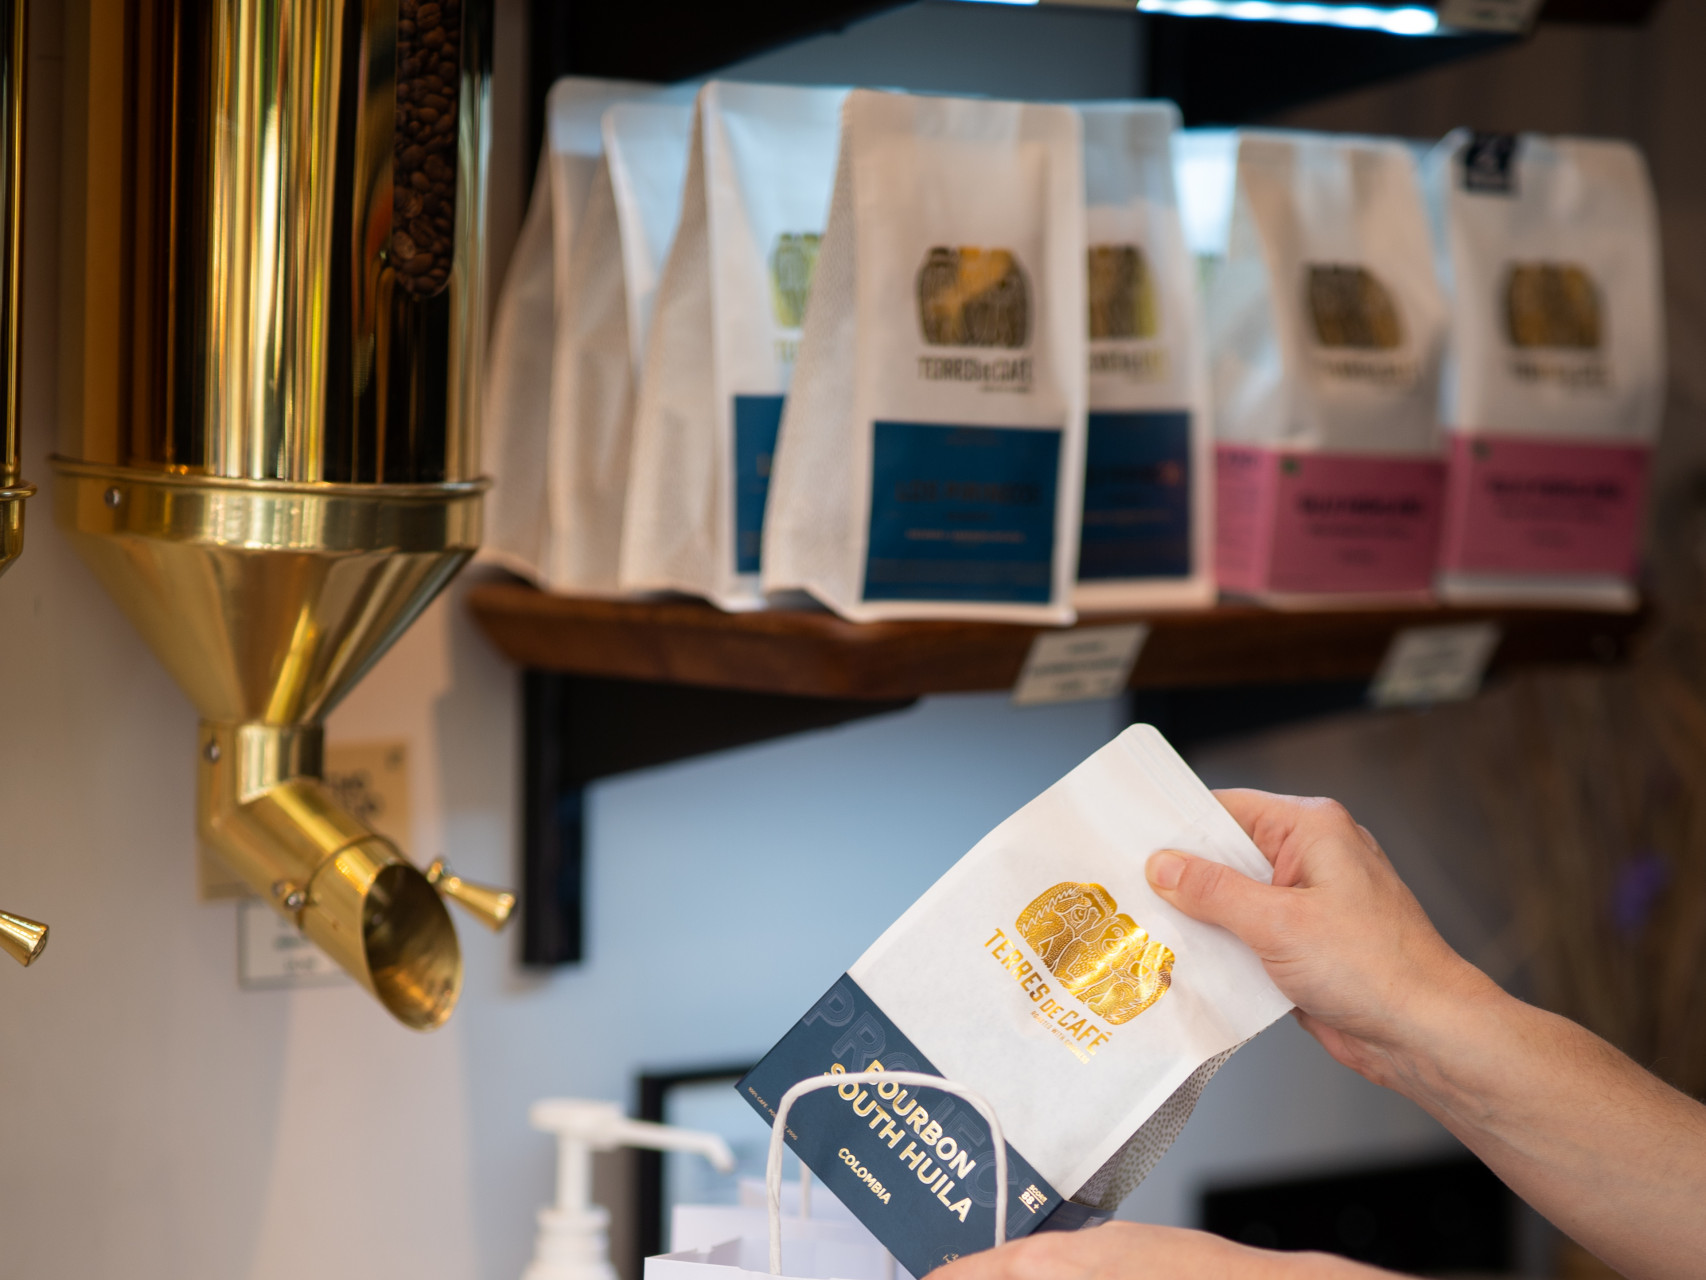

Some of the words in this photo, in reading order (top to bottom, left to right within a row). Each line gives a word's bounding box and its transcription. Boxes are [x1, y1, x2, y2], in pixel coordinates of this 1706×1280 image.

[984, 928, 1051, 1003] TERRES
[1039, 998, 1065, 1020] DE
[1057, 1010, 1113, 1056] CAFÉ
[838, 1147, 893, 1205] COLOMBIA
[899, 1141, 973, 1223] HUILA
